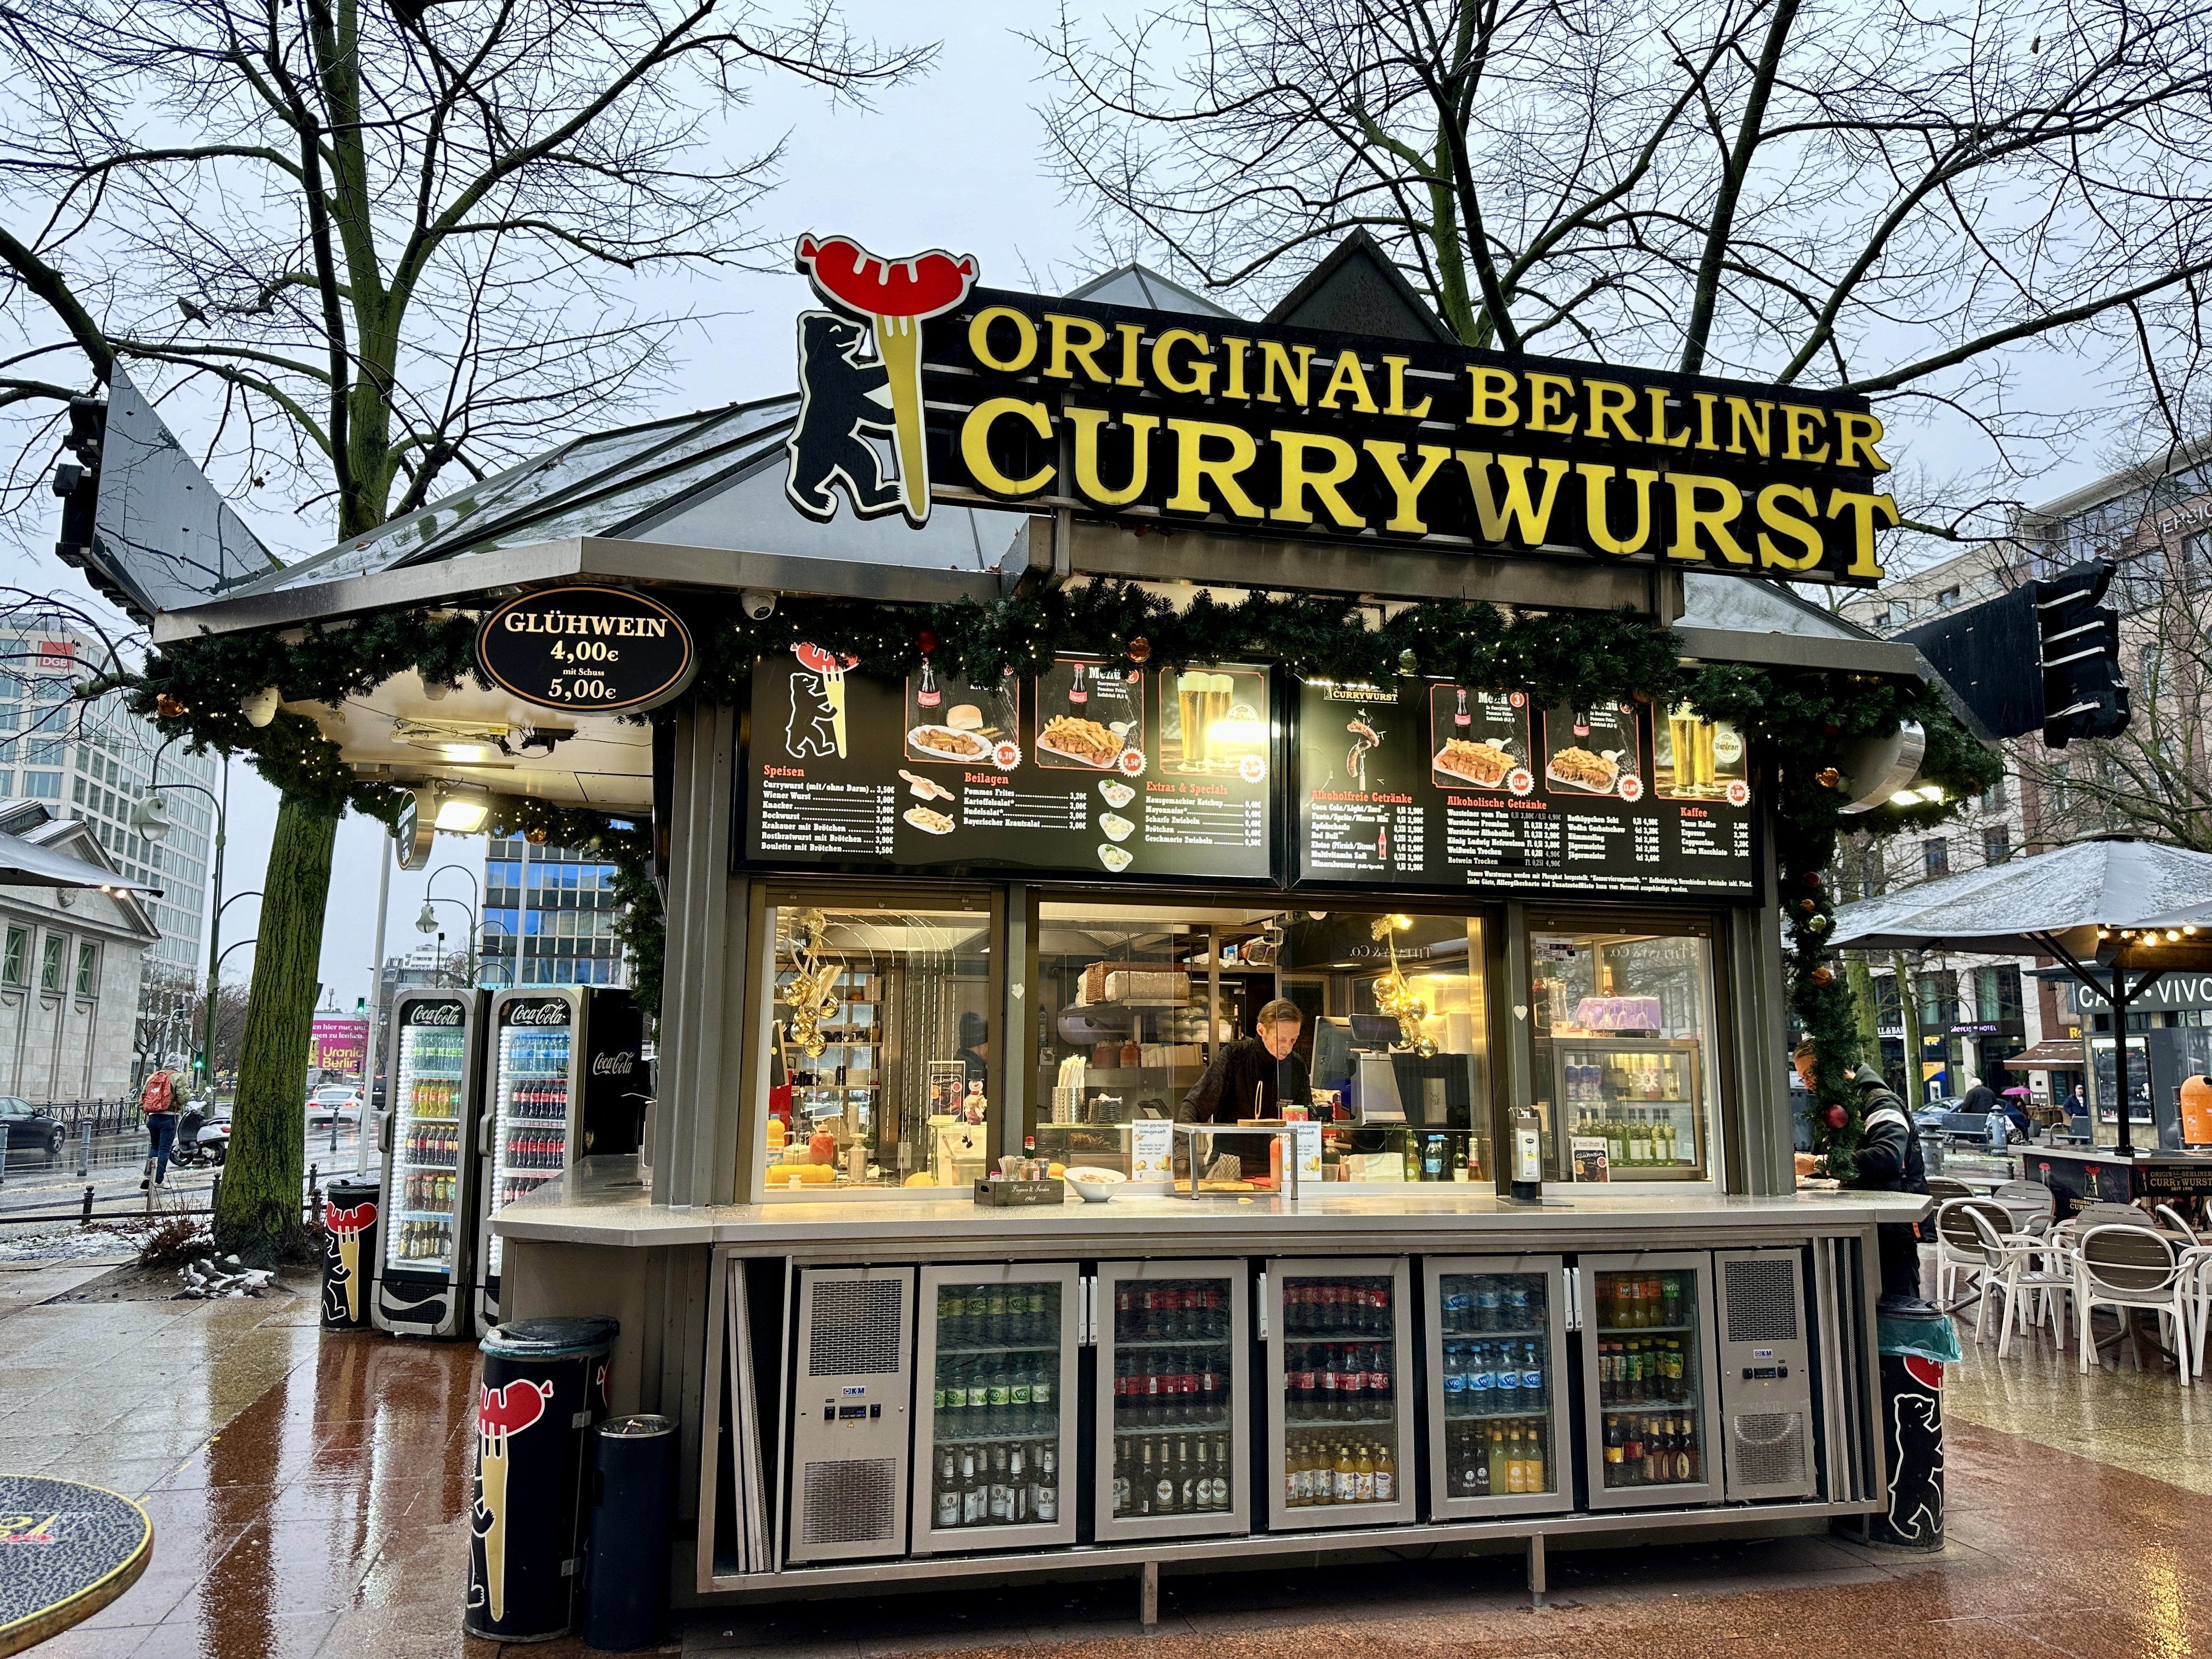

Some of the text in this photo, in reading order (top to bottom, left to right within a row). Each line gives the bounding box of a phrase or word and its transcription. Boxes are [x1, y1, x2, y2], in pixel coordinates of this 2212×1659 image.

[968, 305, 1892, 476] ORIGINAL BERLINER
[961, 397, 1900, 579] CURRYWURST
[505, 610, 668, 637] GLÜHWEIN
[550, 640, 618, 664] 4,00€
[42, 658, 68, 667] DGB
[549, 679, 616, 701] 5,00€
[1333, 691, 1398, 701] CURRYWURST
[1716, 742, 1739, 751] Warsteiner
[764, 765, 805, 778] Speisen
[964, 772, 1009, 786] Beilagen
[764, 780, 895, 794] Currywurst (mit/ohne Darm) 3,50€
[1146, 781, 1228, 795] Extras & Specials
[763, 791, 788, 799] Wiener
[964, 787, 992, 795] Pommes
[1070, 792, 1087, 800] 3,20€
[1311, 790, 1412, 803] Alkoholfreie Getränke
[763, 801, 793, 809] Knacker
[1070, 802, 1086, 810] 3,00€
[1146, 796, 1195, 805] Hausgemachter
[1197, 798, 1223, 808] Ketchup
[1447, 796, 1547, 809] Alkoholische Getränke
[763, 811, 894, 825] Bockwurst 3,00€
[1069, 812, 1086, 820] 3,00€
[1680, 807, 1707, 817] Kaffee
[963, 817, 1086, 830] Bayerischer Krautsalat 3,00€
[1172, 816, 1200, 825] Zwiebeln
[762, 822, 795, 830] Krakauer
[876, 826, 894, 834] 3,90€
[1447, 827, 1515, 837] Warsteiner Alkoholfrei
[1681, 829, 1706, 837] Espresso
[762, 832, 811, 840] Rostbratwurst
[830, 834, 862, 843] Brötchen
[1184, 836, 1212, 844] Zwiebeln
[1447, 837, 1465, 846] König
[1468, 838, 1489, 847] Ludwig
[1681, 838, 1714, 847] Cappuccino
[761, 842, 792, 850] Boulette
[810, 844, 842, 852] Brötchen
[875, 847, 893, 855] 3,50€
[1699, 848, 1728, 856] Macchiato
[1311, 860, 1356, 868] Mineralwasser
[410, 1005, 462, 1025] Coca-Cola
[511, 1004, 566, 1025] Coca-Cola
[592, 1052, 634, 1075] Coca-Cola
